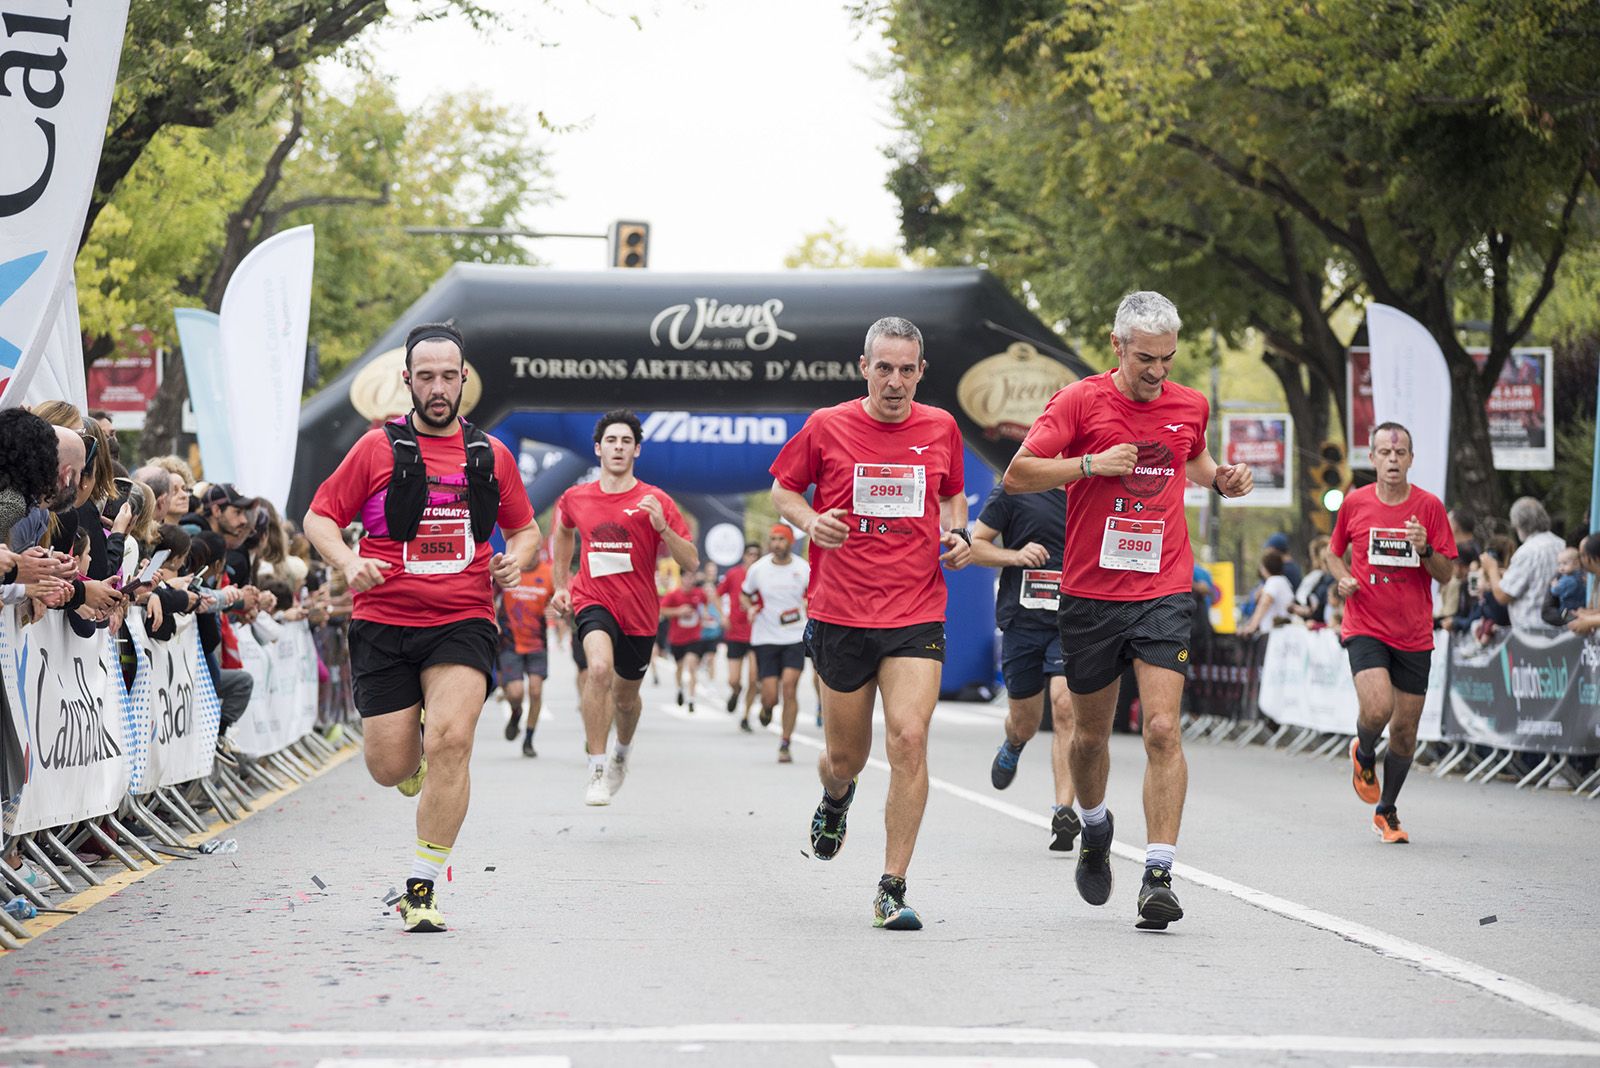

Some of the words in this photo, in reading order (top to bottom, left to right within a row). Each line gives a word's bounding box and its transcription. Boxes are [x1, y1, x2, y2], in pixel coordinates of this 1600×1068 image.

[0, 0, 73, 218] Cai
[649, 297, 798, 351] Vicens
[510, 356, 628, 379] TORRONS
[632, 358, 753, 380] ARTESANS
[765, 360, 863, 381] D'AGRA
[641, 410, 788, 445] MIZUNO
[870, 485, 903, 496] 2991
[420, 542, 454, 554] 3551
[1118, 538, 1152, 552] 2990
[1379, 540, 1407, 550] XAVIER
[1030, 582, 1058, 590] FERNANDO
